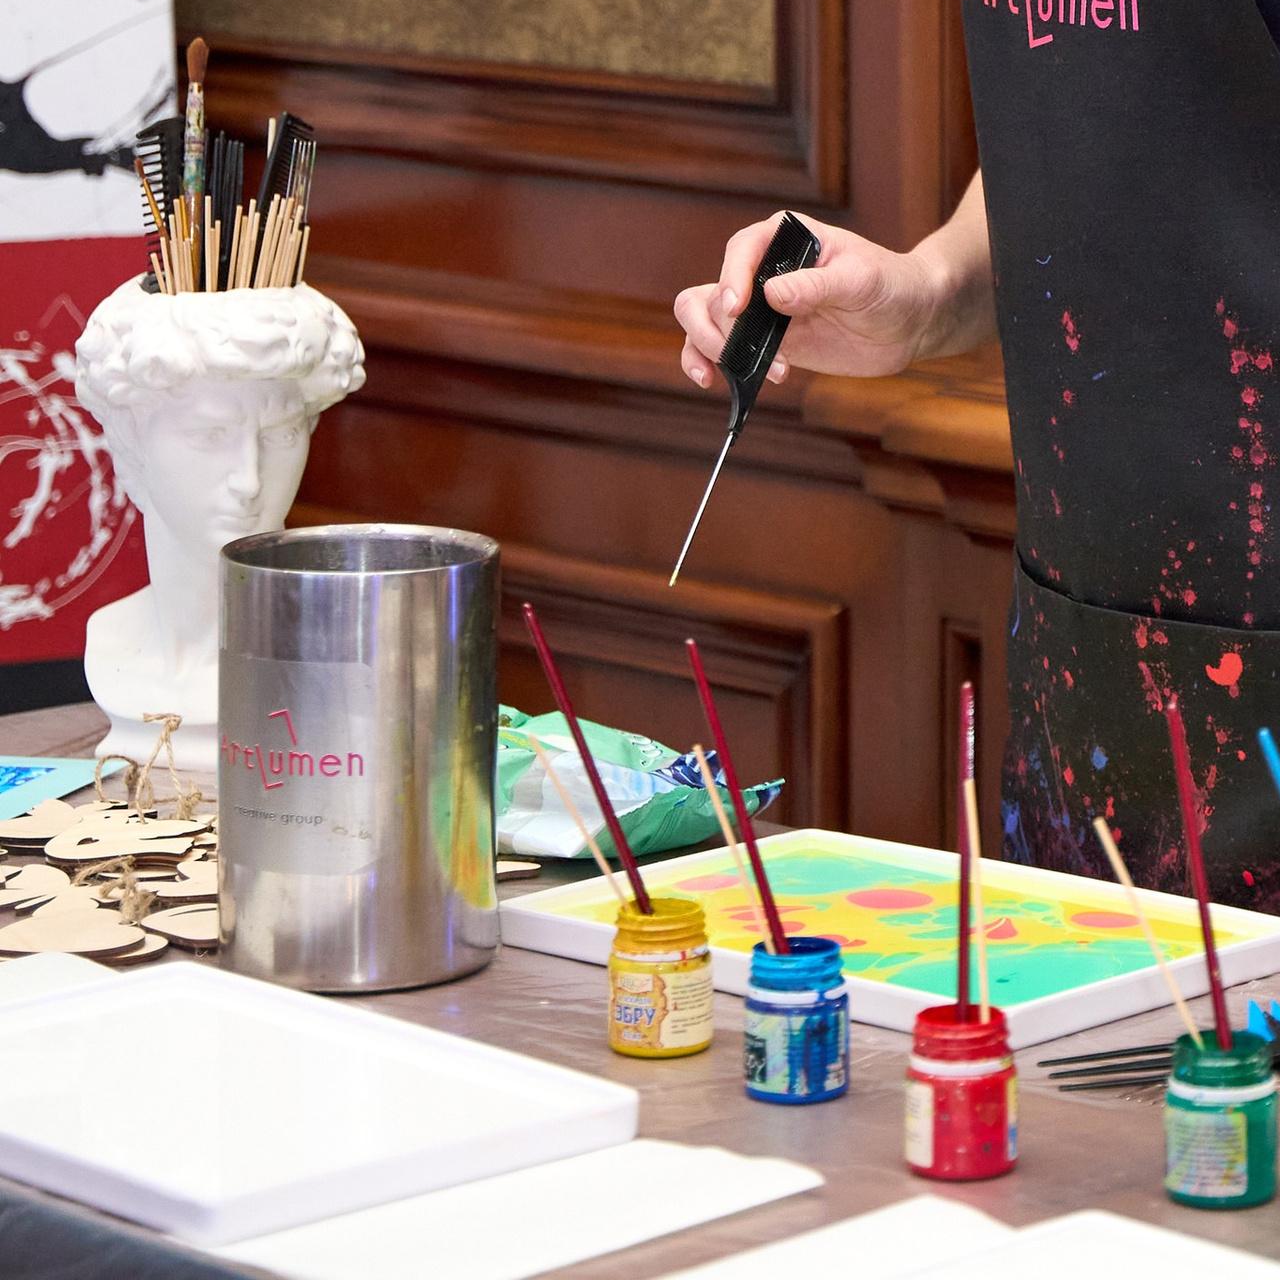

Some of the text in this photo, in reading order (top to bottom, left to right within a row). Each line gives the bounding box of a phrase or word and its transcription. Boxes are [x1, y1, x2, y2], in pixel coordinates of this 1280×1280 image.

[221, 731, 364, 791] ArtLumen
[281, 812, 324, 827] group
[615, 1003, 657, 1026] ЭБРУ
